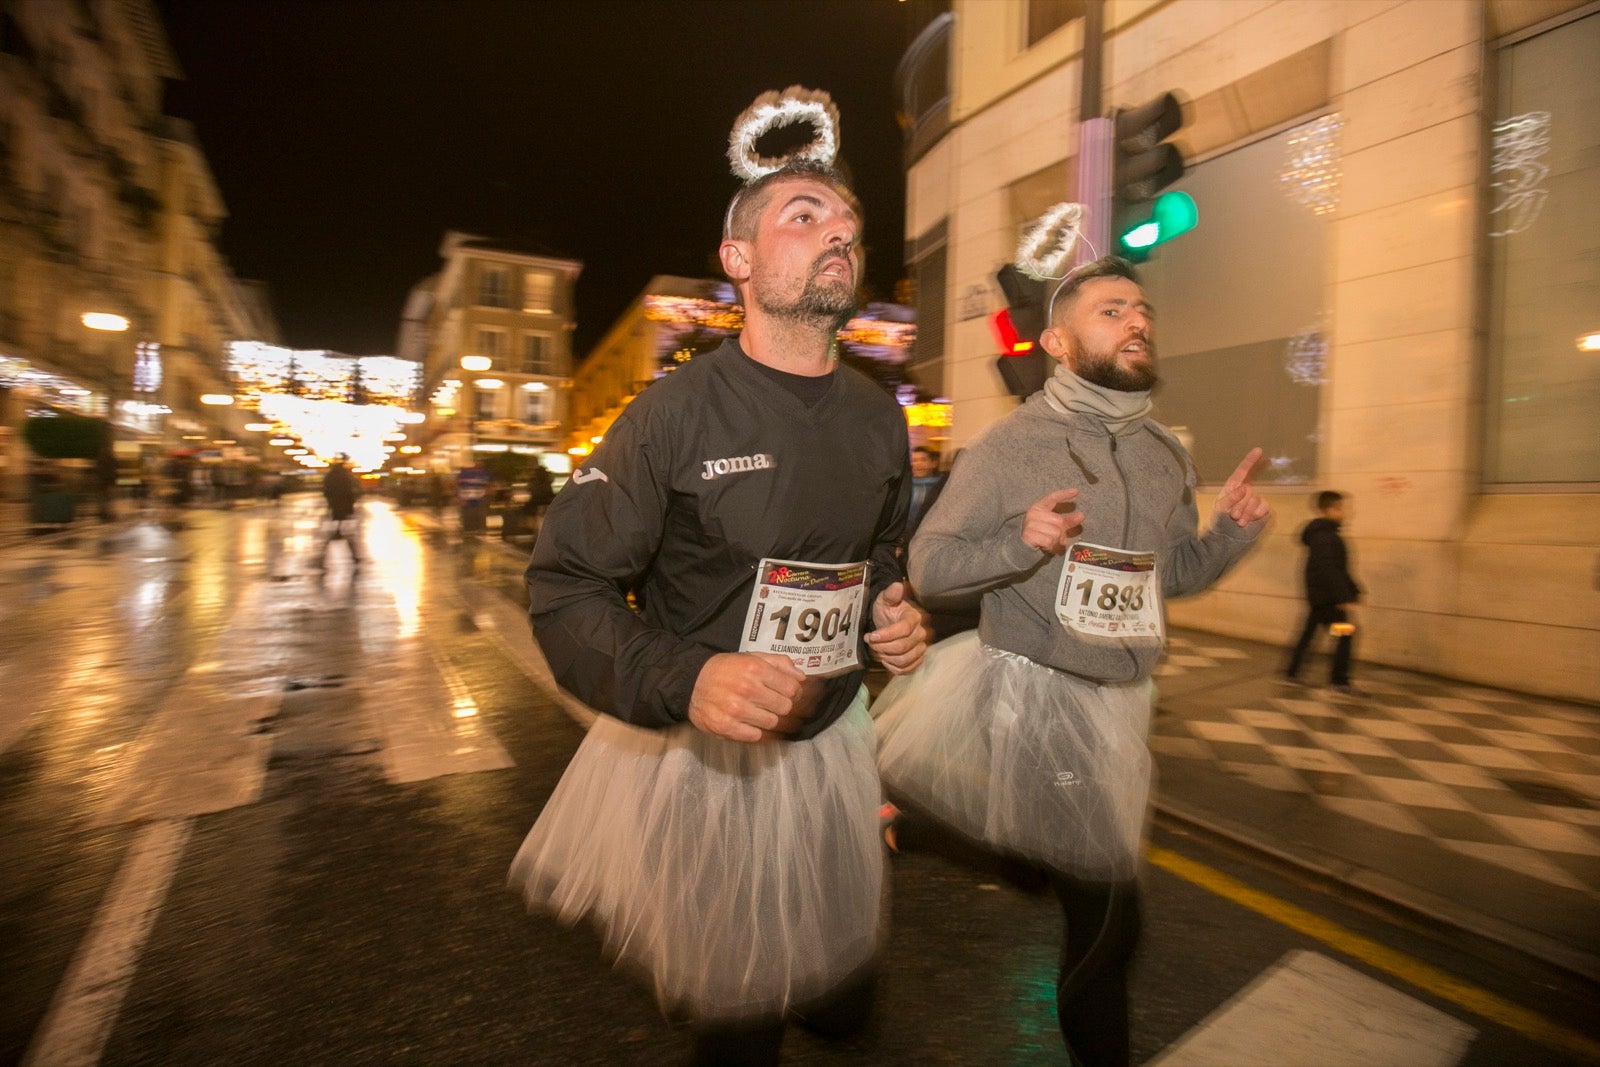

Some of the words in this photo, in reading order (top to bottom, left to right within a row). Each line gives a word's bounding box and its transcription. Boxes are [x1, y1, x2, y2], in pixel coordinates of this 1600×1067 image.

[767, 566, 789, 584] 28
[775, 574, 811, 584] Nocturna
[1076, 578, 1144, 612] 1893
[769, 603, 853, 643] 1904
[770, 643, 802, 655] ALEJANDRO
